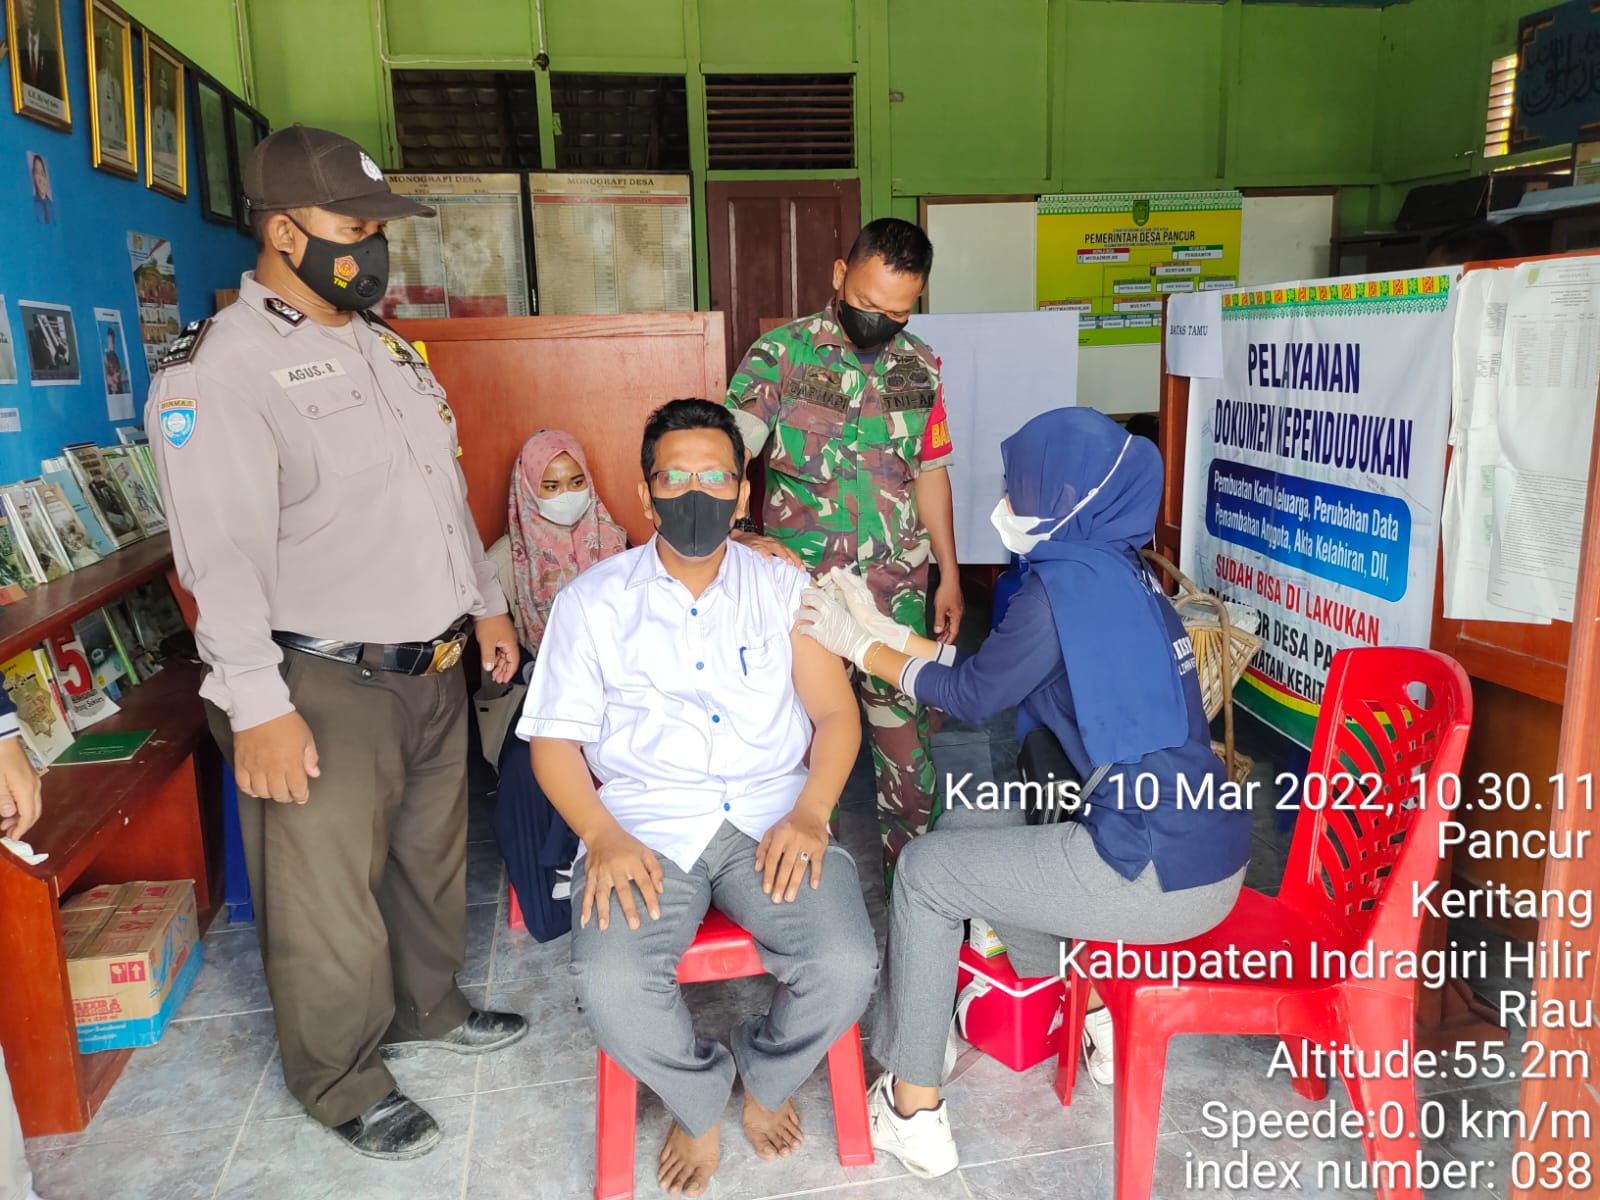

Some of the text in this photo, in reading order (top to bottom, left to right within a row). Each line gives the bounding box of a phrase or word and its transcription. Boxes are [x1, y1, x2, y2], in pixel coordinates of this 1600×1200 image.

[1084, 230, 1195, 244] PEMERINTAH DESA PANCUR
[334, 277, 348, 289] TNI
[1170, 325, 1186, 335] BATAS
[1188, 325, 1208, 336] TAMU
[1248, 343, 1361, 394] PELAYANAN
[1214, 399, 1413, 479] DOKUMEN KEPENDUDUKAN
[1213, 470, 1252, 500] Pembuatan
[1254, 480, 1273, 507] Kartu
[1313, 495, 1369, 534] Perubahan
[1372, 508, 1399, 542] Data
[1215, 503, 1260, 536] Penambahan
[1260, 518, 1291, 554] Anggota,
[1294, 527, 1313, 557] Akta
[1315, 534, 1367, 579] Kelahiran,
[1215, 553, 1254, 592] SUDAH
[1256, 570, 1282, 607] BISA
[1285, 583, 1300, 614] DI
[1305, 591, 1380, 647] LAKUKAN
[52, 622, 92, 696] 5
[1273, 619, 1309, 662] DESA
